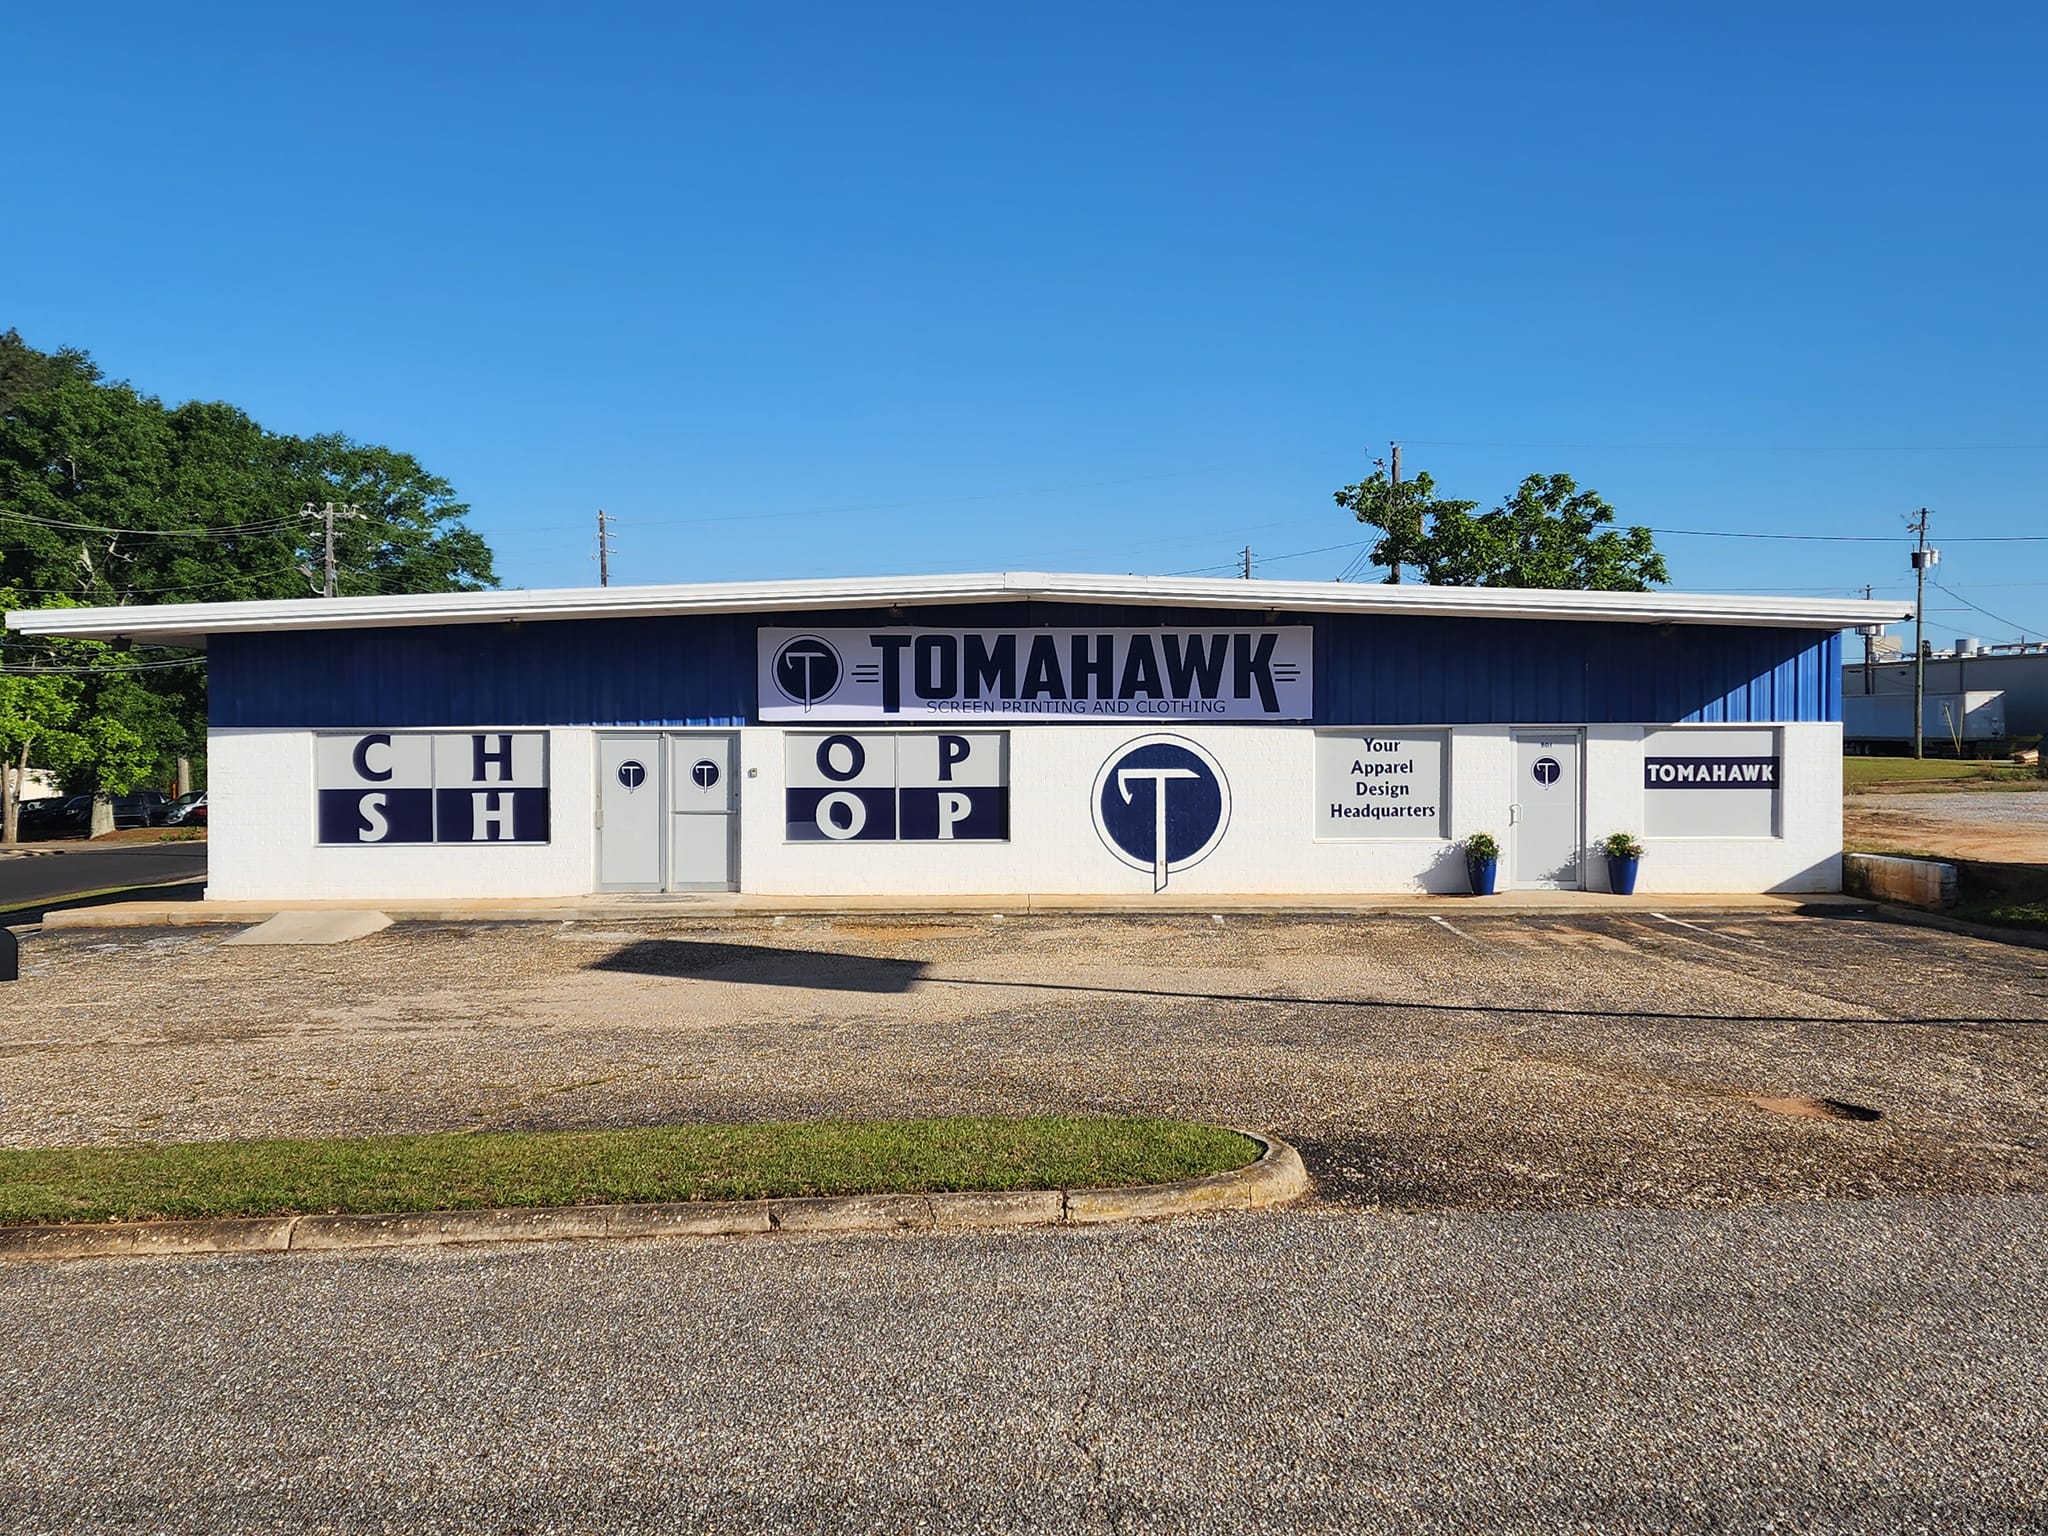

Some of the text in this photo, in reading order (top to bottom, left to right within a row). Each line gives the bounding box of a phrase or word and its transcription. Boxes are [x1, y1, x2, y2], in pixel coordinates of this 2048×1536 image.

[868, 634, 1281, 713] TOMAHAWK
[926, 700, 1226, 714] SCREEN PRINTING AND CLOTHING
[1363, 737, 1401, 753] Your
[1350, 759, 1414, 777] Apparel
[1647, 764, 1774, 782] TOMAHAWK
[1356, 781, 1410, 799] Design
[1330, 803, 1436, 820] Headquarters
